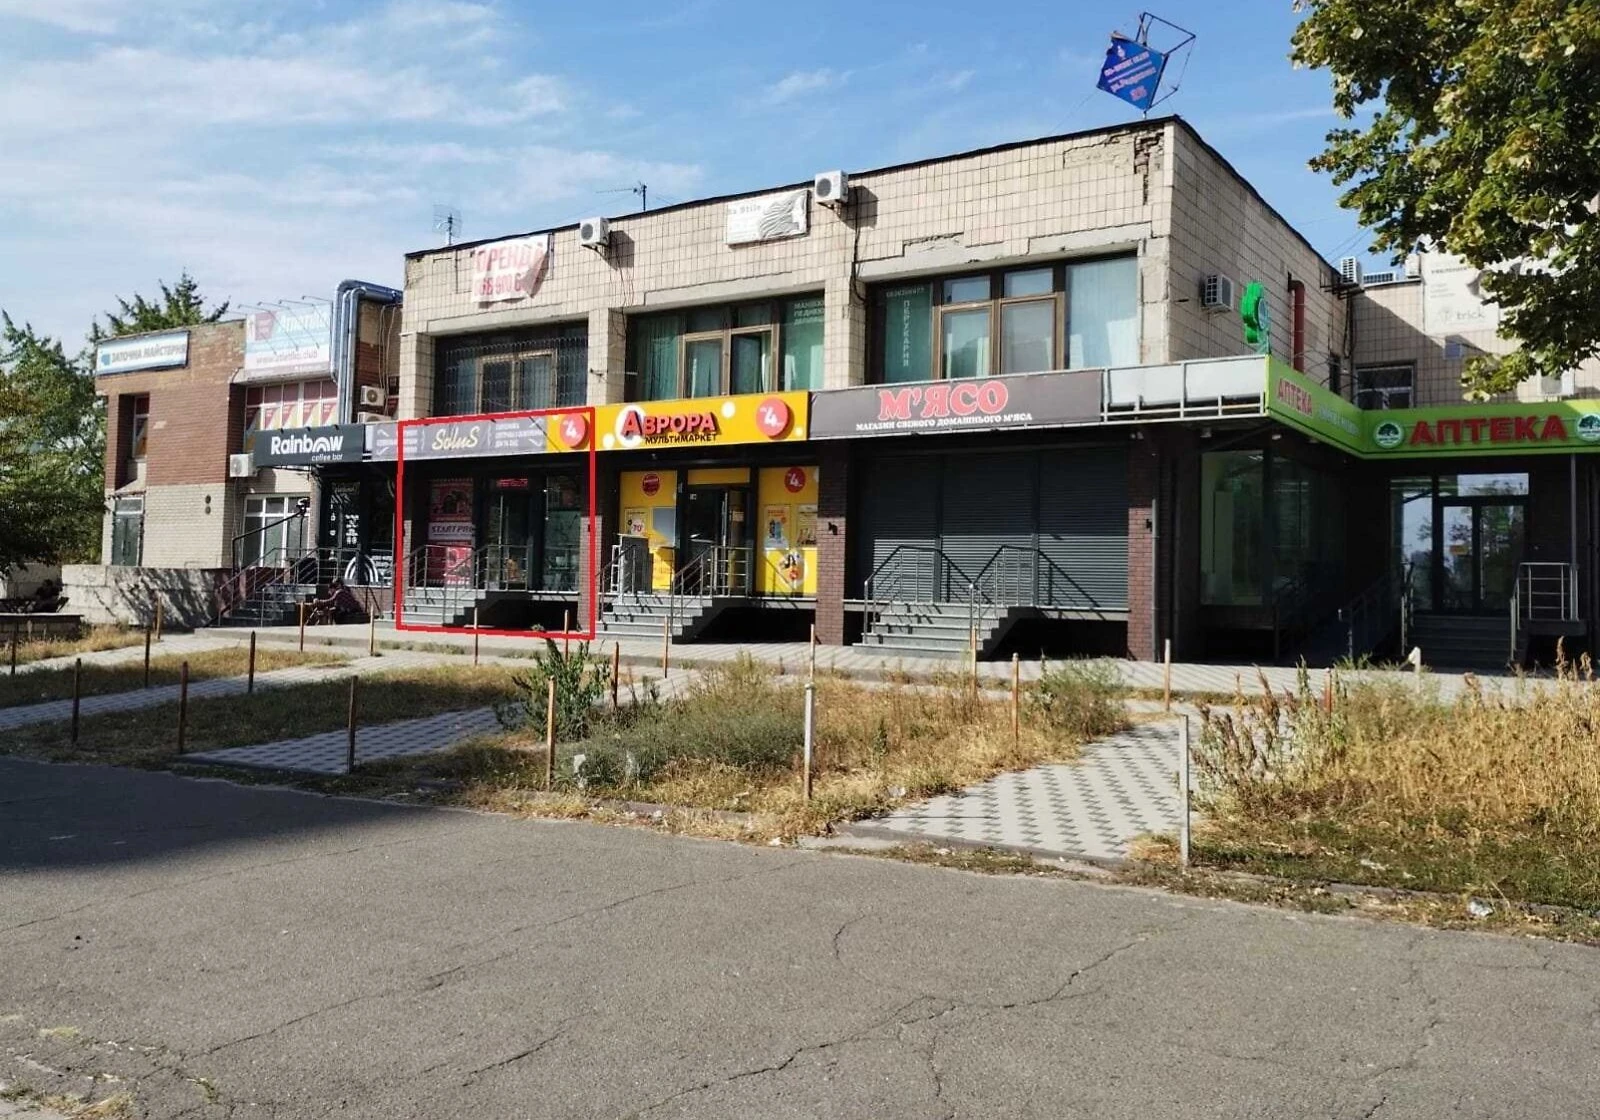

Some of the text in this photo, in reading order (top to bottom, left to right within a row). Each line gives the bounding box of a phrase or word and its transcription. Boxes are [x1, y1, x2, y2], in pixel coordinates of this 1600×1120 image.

[877, 380, 1009, 421] М'ЯСО
[1277, 378, 1313, 417] АПТЕКА
[621, 410, 717, 437] АВРОРА
[855, 412, 1032, 431] МАГАЗИН СВІЖОГО ДОМАШНЬОГО М'ЯСА
[1409, 413, 1569, 447] АПТЕКА
[270, 434, 344, 455] Rainbow
[645, 433, 717, 445] МУЛЬТИМАРКЕТ
[311, 453, 343, 462] coffee bar
